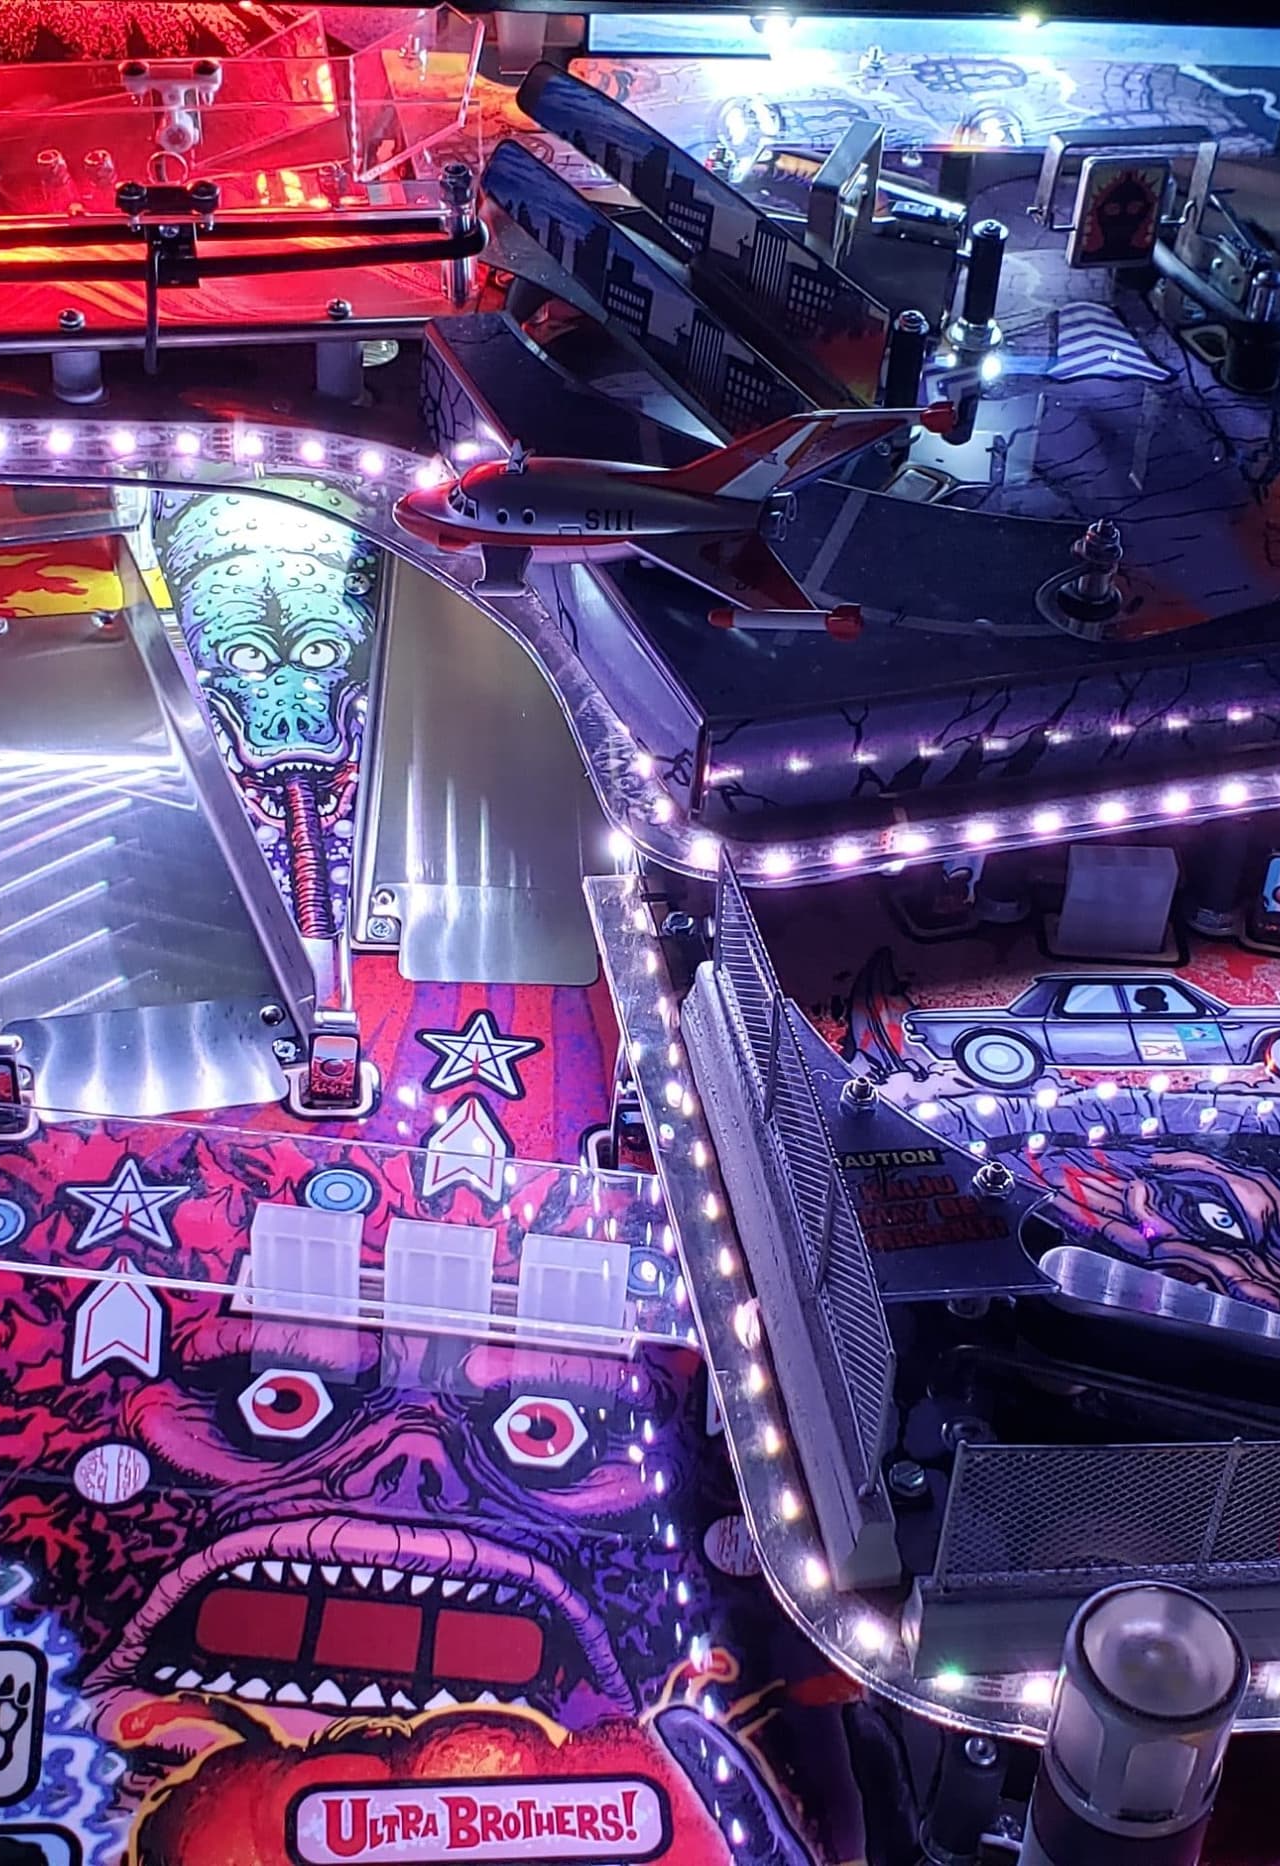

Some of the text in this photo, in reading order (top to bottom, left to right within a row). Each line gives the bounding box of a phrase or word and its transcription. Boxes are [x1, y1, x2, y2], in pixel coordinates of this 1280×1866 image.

[834, 1149, 938, 1168] AUTION
[322, 1790, 638, 1856] ULTRA BROTHERS!
